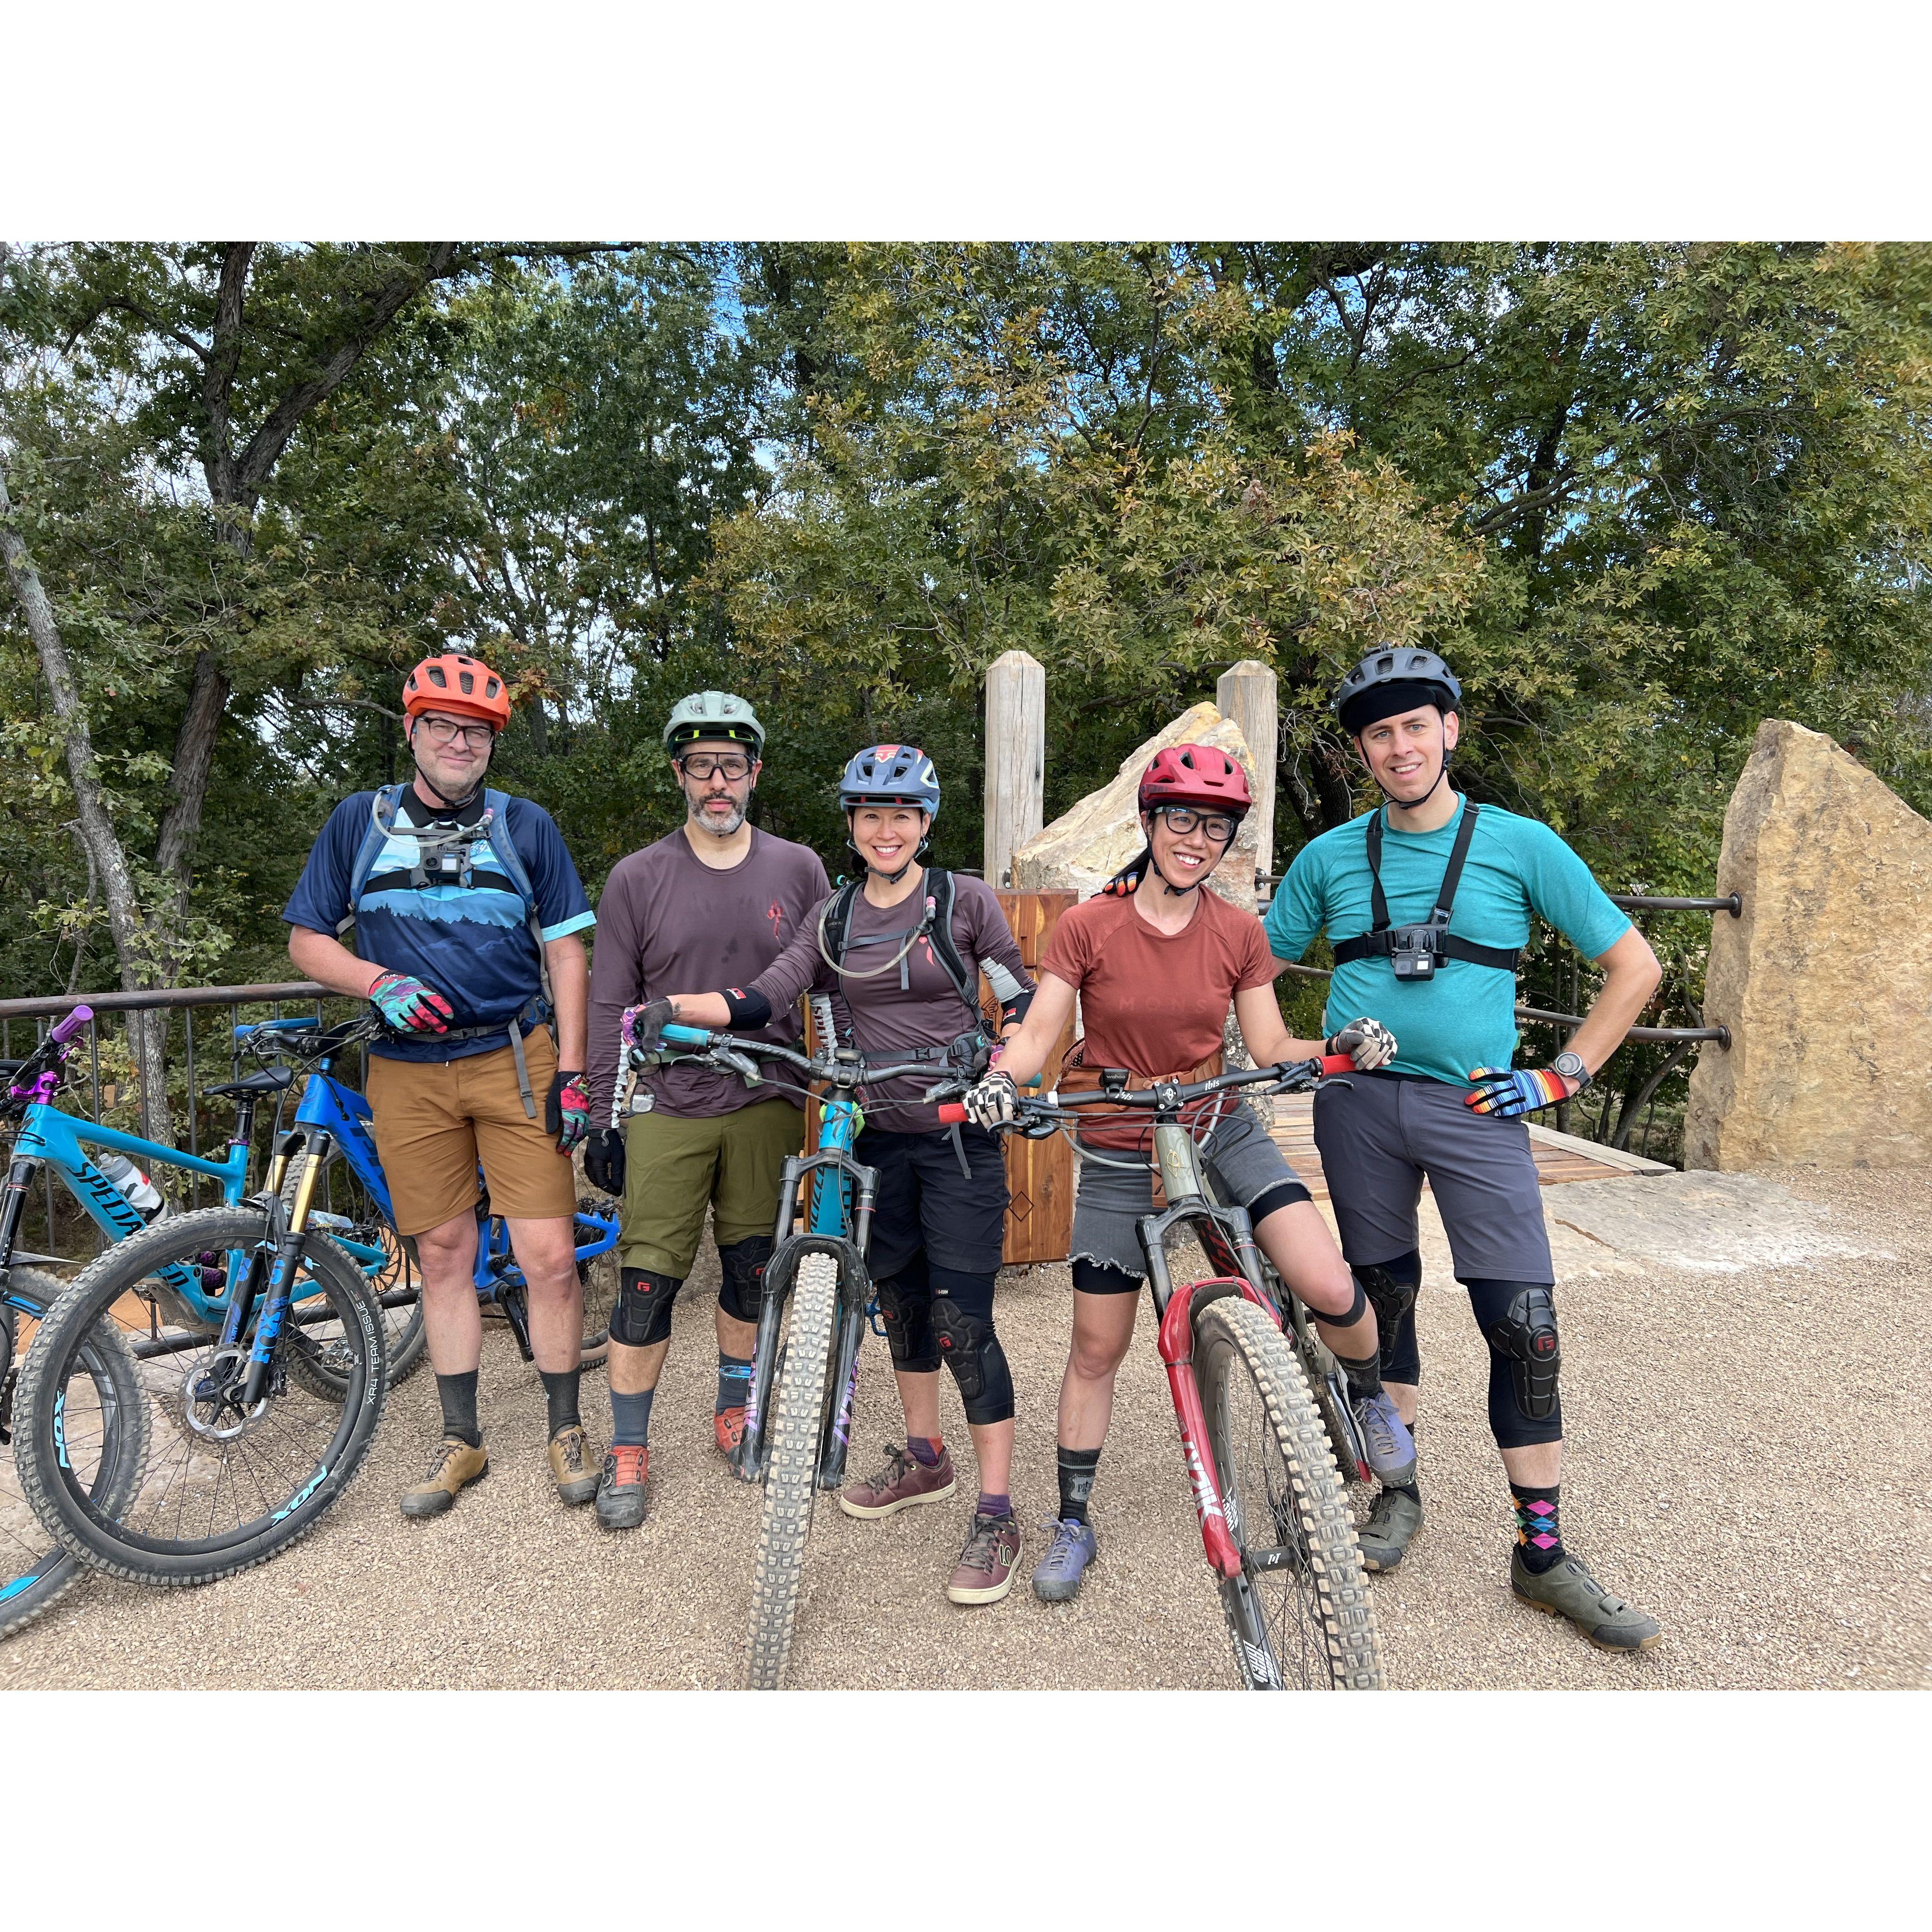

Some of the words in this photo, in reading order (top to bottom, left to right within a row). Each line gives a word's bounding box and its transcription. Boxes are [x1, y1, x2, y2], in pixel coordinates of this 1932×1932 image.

[1115, 1092, 1134, 1101] ibis
[1204, 1079, 1220, 1091] ibis
[356, 1300, 375, 1335] ISSUE
[251, 1311, 283, 1364] FOX
[369, 1336, 380, 1373] TEAM
[367, 1378, 379, 1405] XR4
